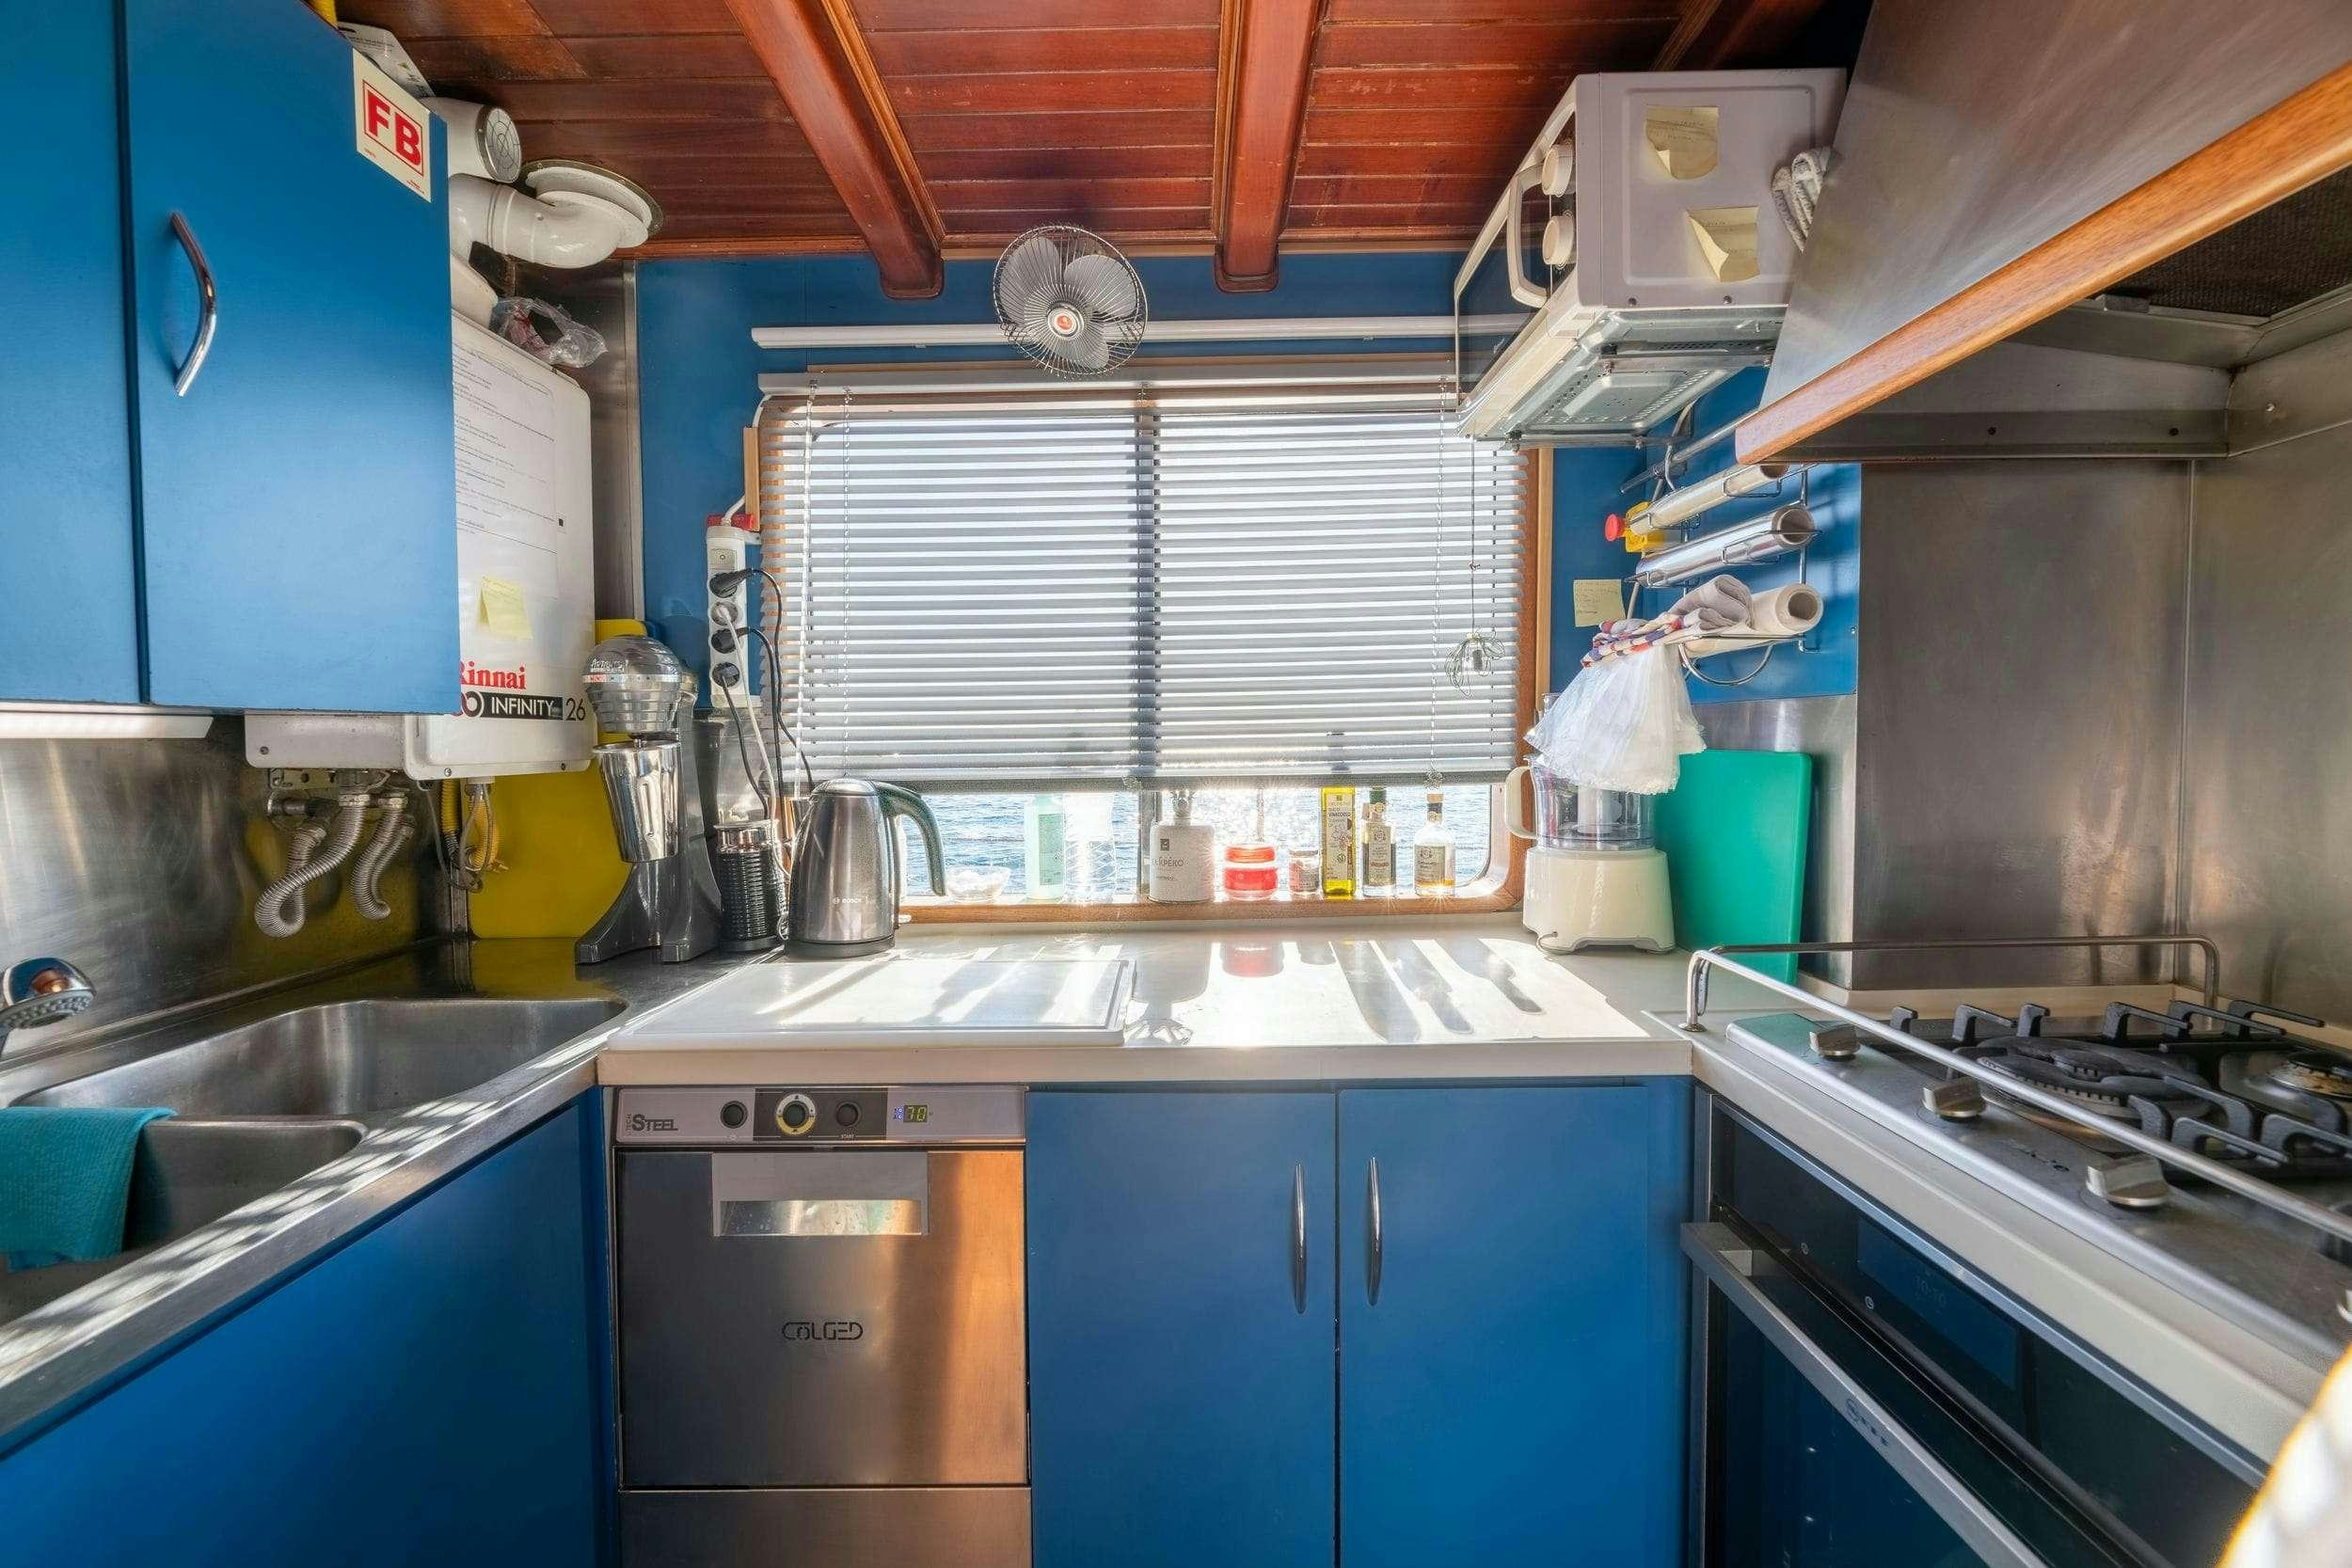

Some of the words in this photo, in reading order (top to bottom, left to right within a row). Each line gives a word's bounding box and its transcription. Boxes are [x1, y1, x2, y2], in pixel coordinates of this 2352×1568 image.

[491, 696, 555, 717] INFINITY
[565, 698, 586, 721] 26
[631, 1113, 678, 1132] STEEL
[907, 1105, 927, 1121] 70
[782, 1322, 864, 1341] COLGED
